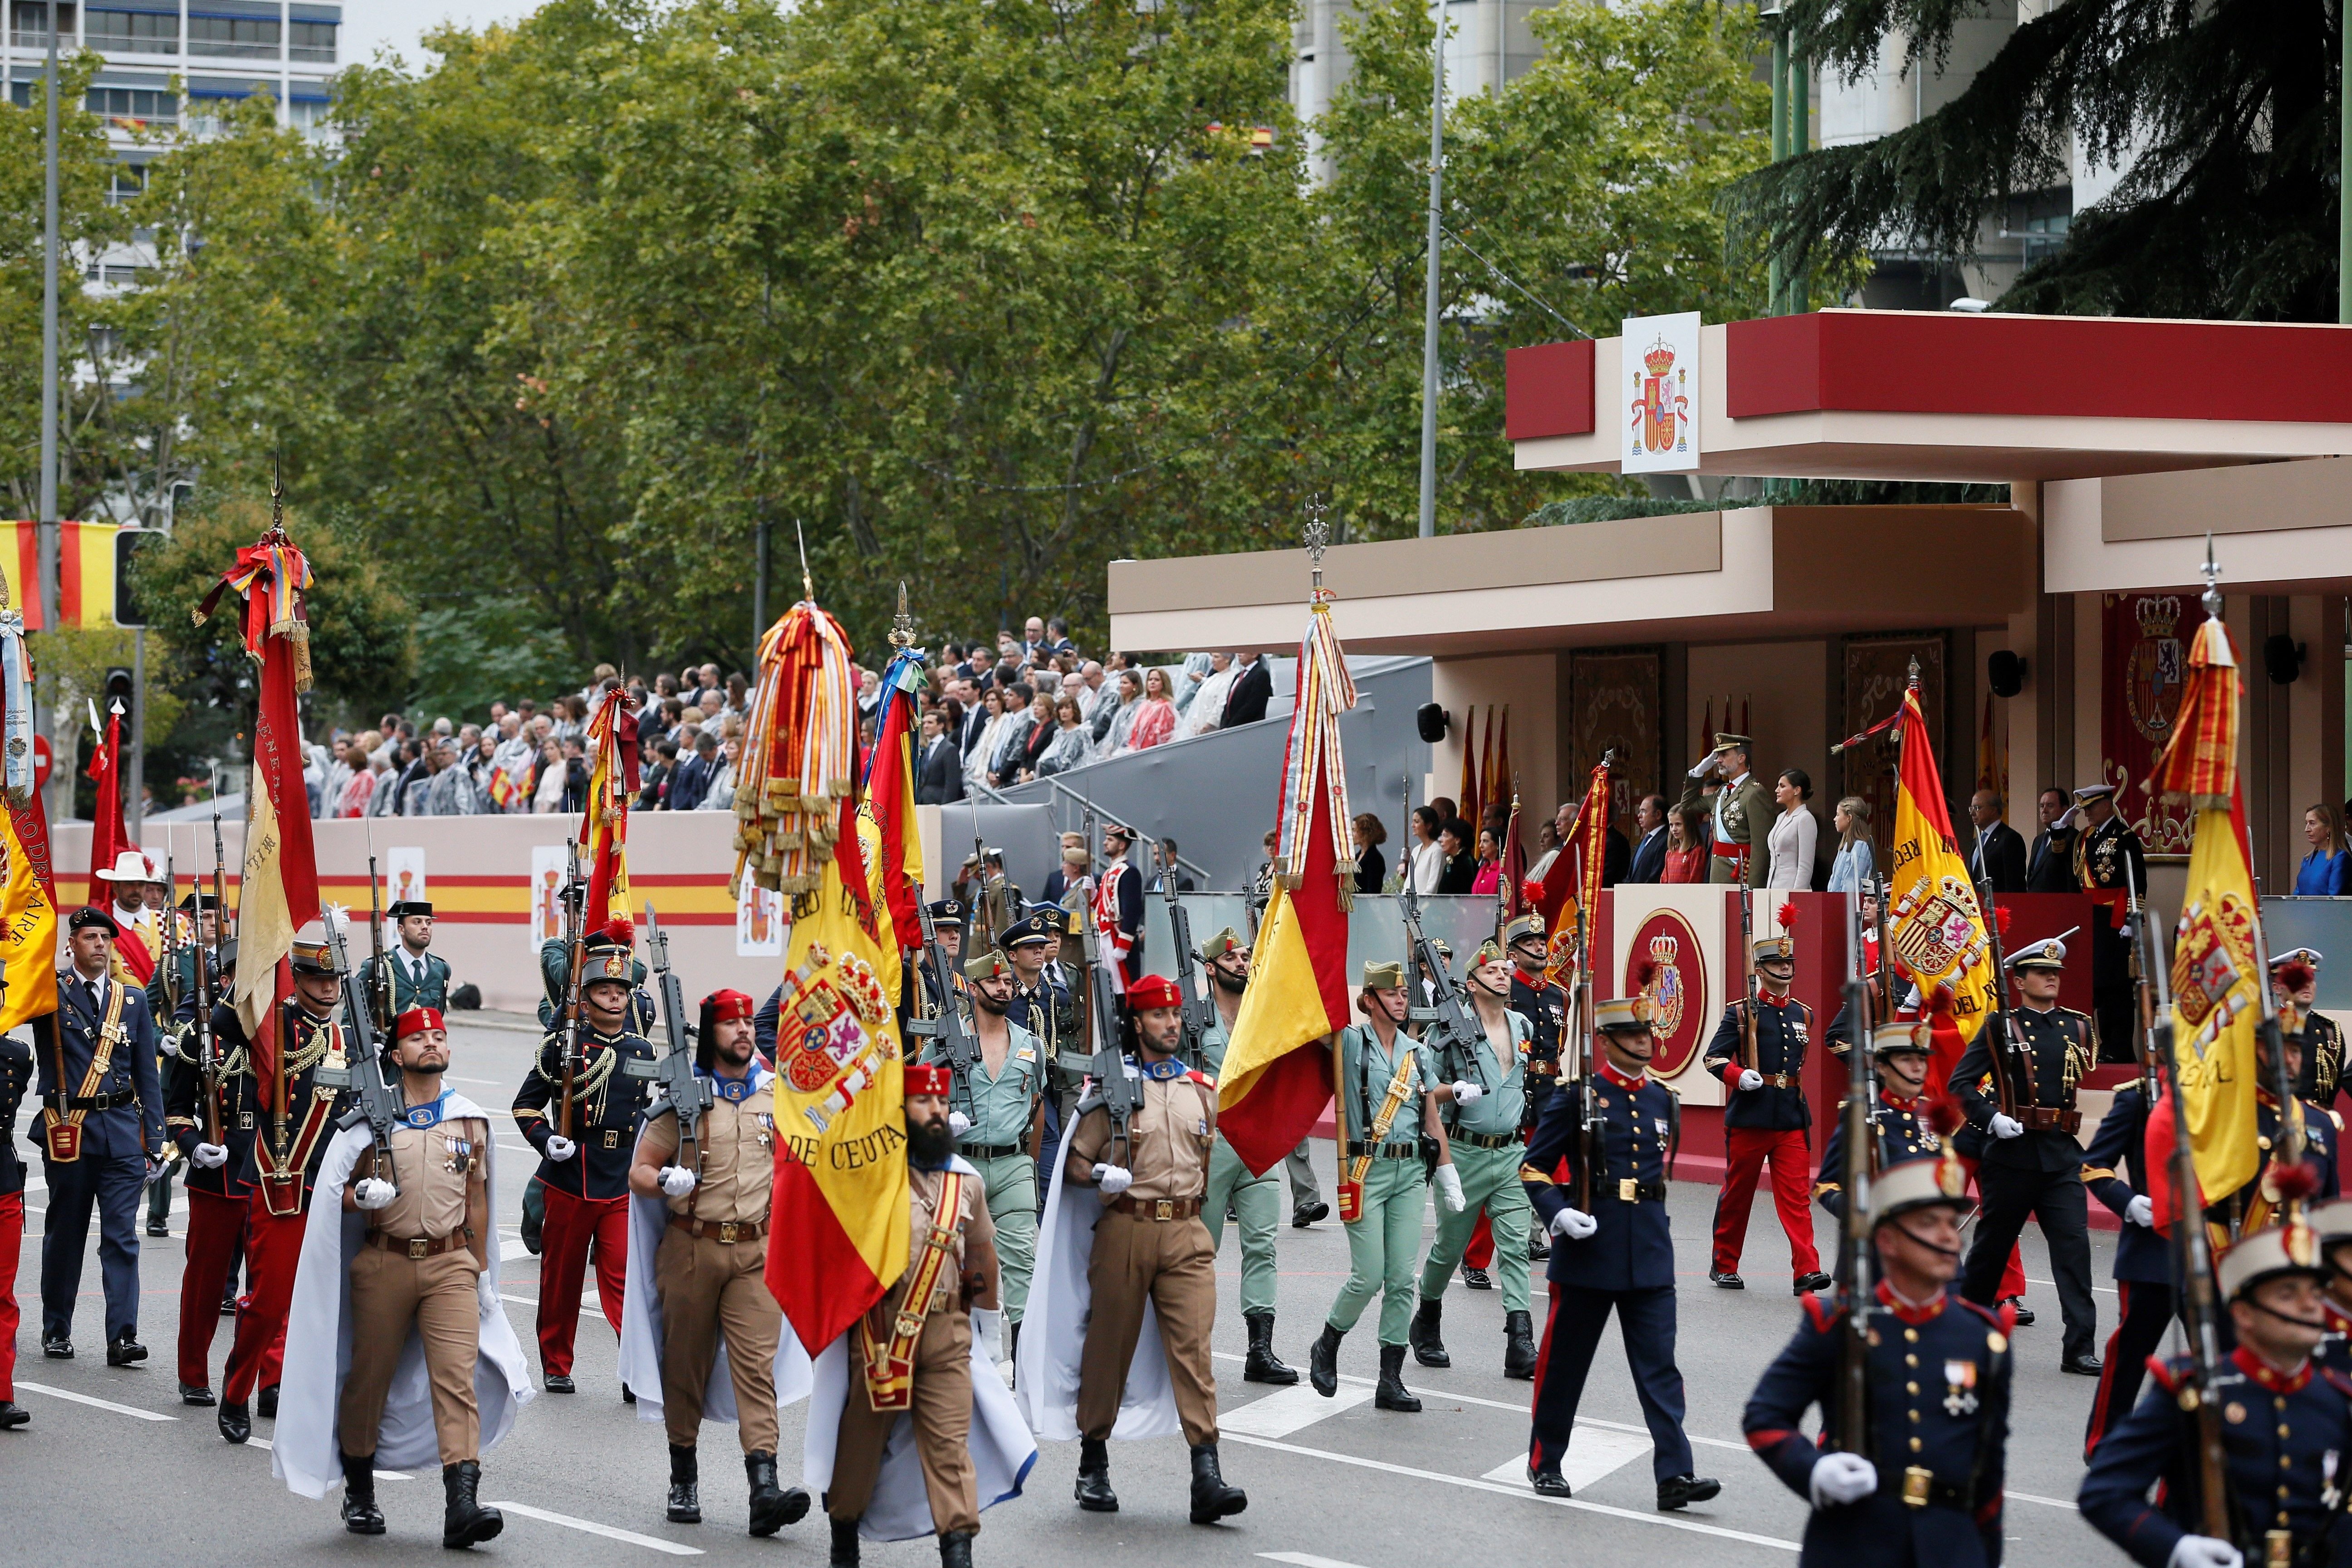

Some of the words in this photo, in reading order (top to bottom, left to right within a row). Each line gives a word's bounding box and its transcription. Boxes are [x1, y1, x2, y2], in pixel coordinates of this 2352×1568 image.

[28, 841, 49, 888] DEL
[9, 894, 44, 946] AIRE
[784, 1135, 820, 1167] DE
[831, 1123, 908, 1170] CEUTA
